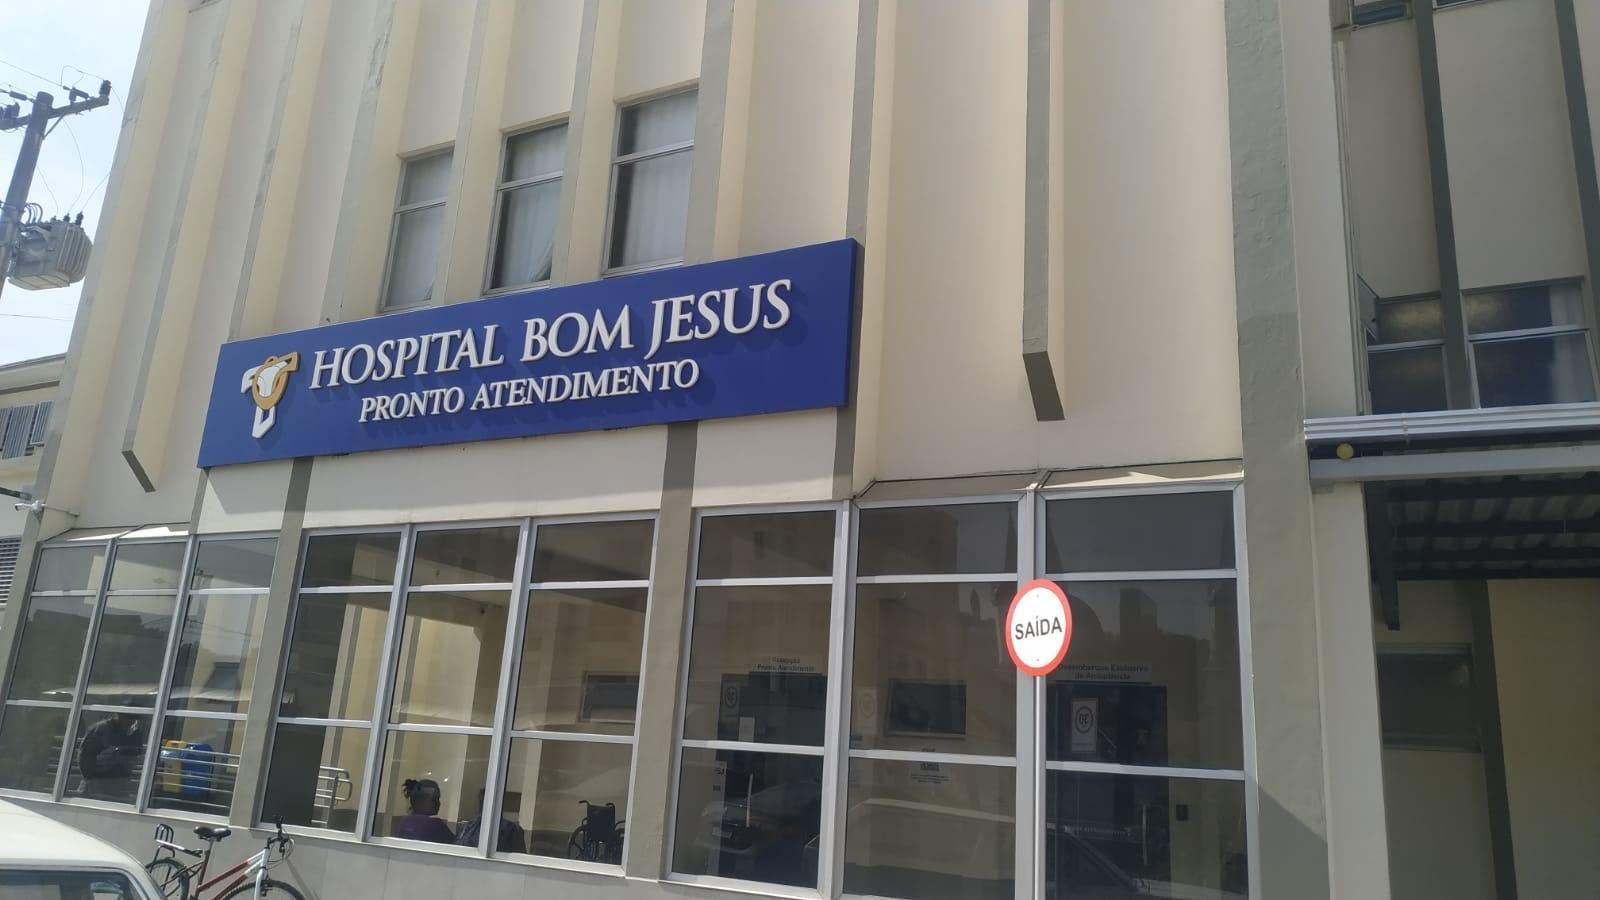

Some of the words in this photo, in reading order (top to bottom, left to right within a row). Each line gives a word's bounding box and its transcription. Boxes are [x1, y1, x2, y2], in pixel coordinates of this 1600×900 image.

[308, 323, 505, 390] HOSPITAL
[519, 304, 635, 362] BOM
[643, 278, 792, 360] JESUS
[358, 386, 465, 423] PRONTO
[470, 358, 700, 411] ATENDIMENTO
[1014, 616, 1063, 640] SAÍDA
